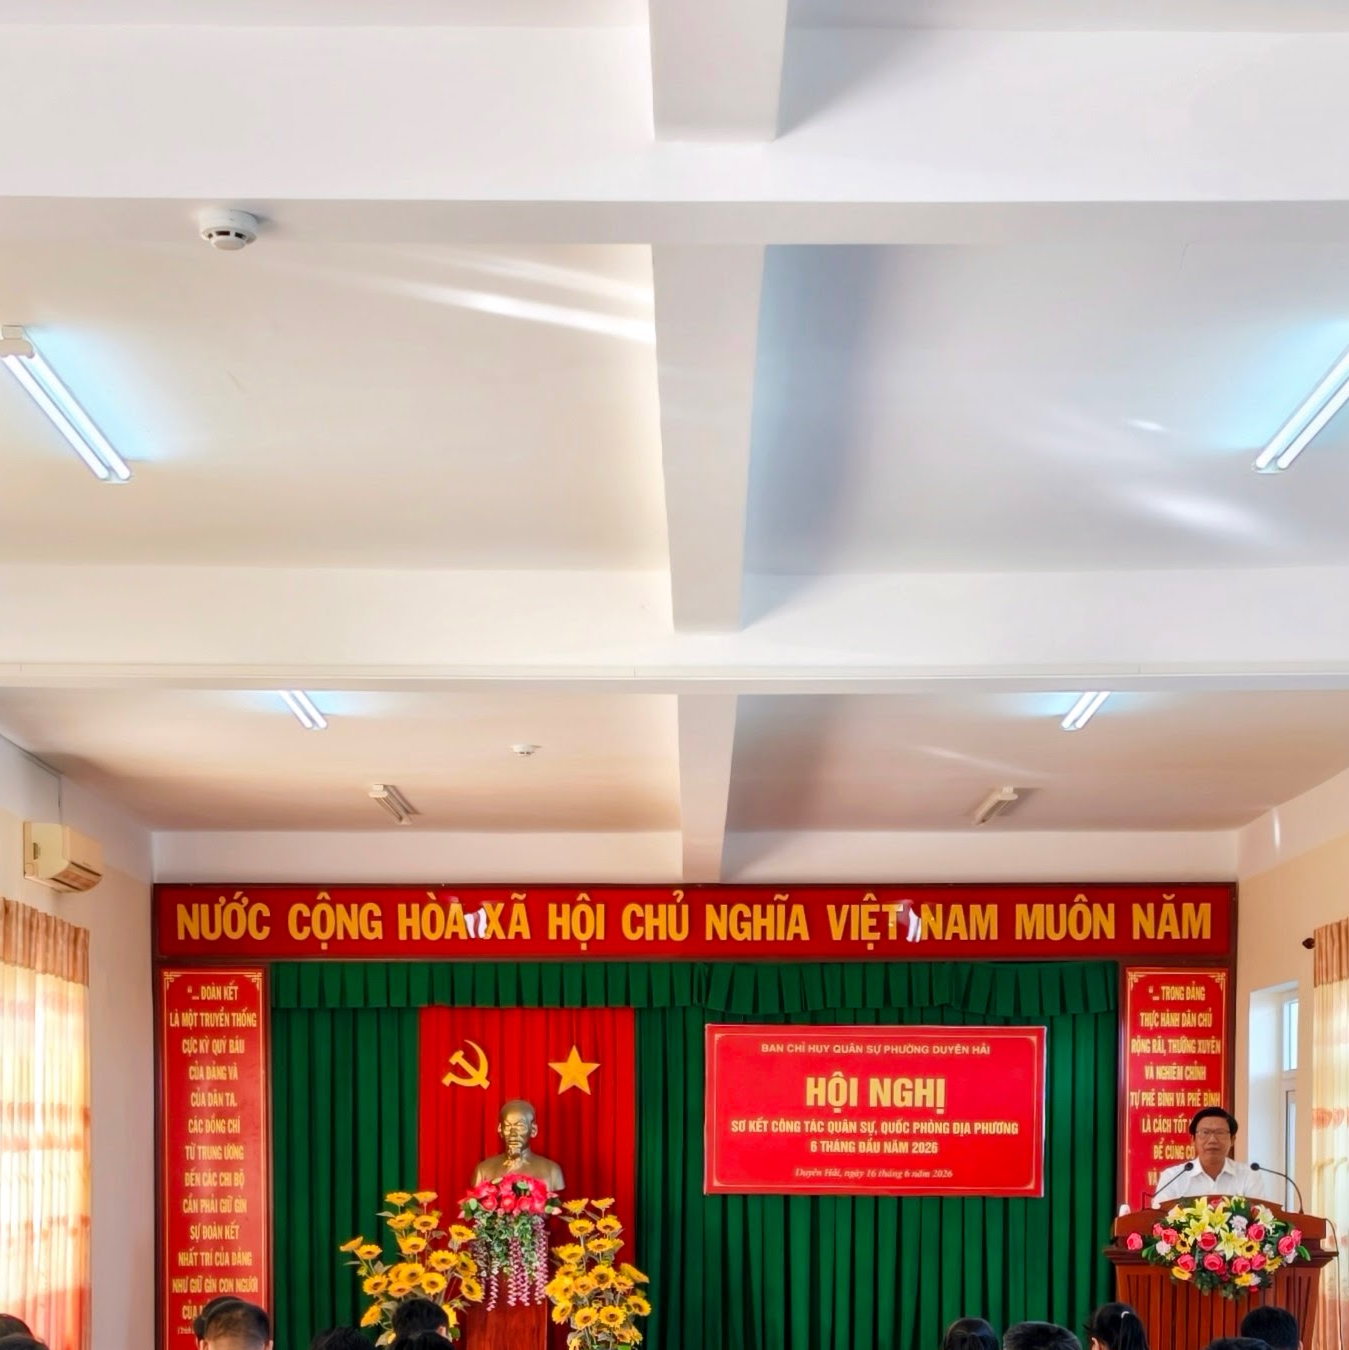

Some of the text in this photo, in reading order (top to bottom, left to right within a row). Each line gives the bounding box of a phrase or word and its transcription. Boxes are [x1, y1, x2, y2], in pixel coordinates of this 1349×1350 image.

[177, 890, 1211, 950] NƯỚC CỘNG HÒA XÃ HỘI CHỦ NGHĨA VIỆT NAM MUÔN NĂM
[201, 982, 221, 1000] ĐOÀN
[224, 980, 239, 1000] KẾT
[1161, 986, 1184, 1000] TRONG
[1186, 981, 1205, 1001] ĐẢNG
[170, 1009, 179, 1027] LÀ
[181, 1008, 198, 1030] MỘT
[231, 1007, 257, 1027] THỐNG
[1140, 1008, 1212, 1030] THỰC HÀNH DÂN CHỦ
[182, 1036, 245, 1056] CỰC KỲ QUÝ BÁU
[762, 1041, 990, 1057] BAN CHỈ HUY QUÂN SỰ PHƯỜNG DUYÊN HẢI
[1131, 1036, 1150, 1056] RỘNG
[1197, 1036, 1221, 1054] XUYÊN
[189, 1061, 238, 1080] CỦA ĐẢNG VÀ
[1145, 1062, 1155, 1080] VÀ
[1156, 1062, 1183, 1080] NGHIÊM
[191, 1088, 237, 1107] CỦA DÂN TA.
[806, 1071, 945, 1114] HỘI NGHỊ
[1130, 1088, 1220, 1109] TỰ PHÊ BÌNH VÀ PHÊ BÌNH
[188, 1115, 203, 1134] CÁC
[227, 1115, 240, 1134] CHÍ
[731, 1117, 1018, 1136] SƠ KẾT CÔNG TÁC QUÂN SỰ, QUỐC PHÒNG ĐỊA PHƯƠNG
[1142, 1115, 1151, 1133] LÀ
[1153, 1115, 1171, 1133] CÁCH
[1173, 1114, 1187, 1133] TỐT
[185, 1142, 244, 1160] TỪ TRUNG ƯƠNG
[811, 1137, 938, 1153] 6 THÁNG ĐẦU NĂM 2026
[1153, 1137, 1164, 1160] ĐỂ
[1165, 1140, 1184, 1160] CỦNG
[185, 1168, 244, 1189] ĐẾN CÁC CHI BỘ
[795, 1168, 822, 1178] Duyên
[879, 1169, 902, 1179] tháng
[912, 1170, 931, 1178] năm
[201, 1195, 218, 1213] PHẢI
[234, 1196, 247, 1213] GÌN
[190, 1220, 239, 1243] SỰ ĐOÀN KẾT
[178, 1247, 252, 1266] NHẤT TRÍ CỦA ĐẢNG
[172, 1276, 188, 1293] NHƯ
[205, 1276, 217, 1293] GÌN
[219, 1278, 234, 1293] CON
[182, 1299, 197, 1320] CỦA
